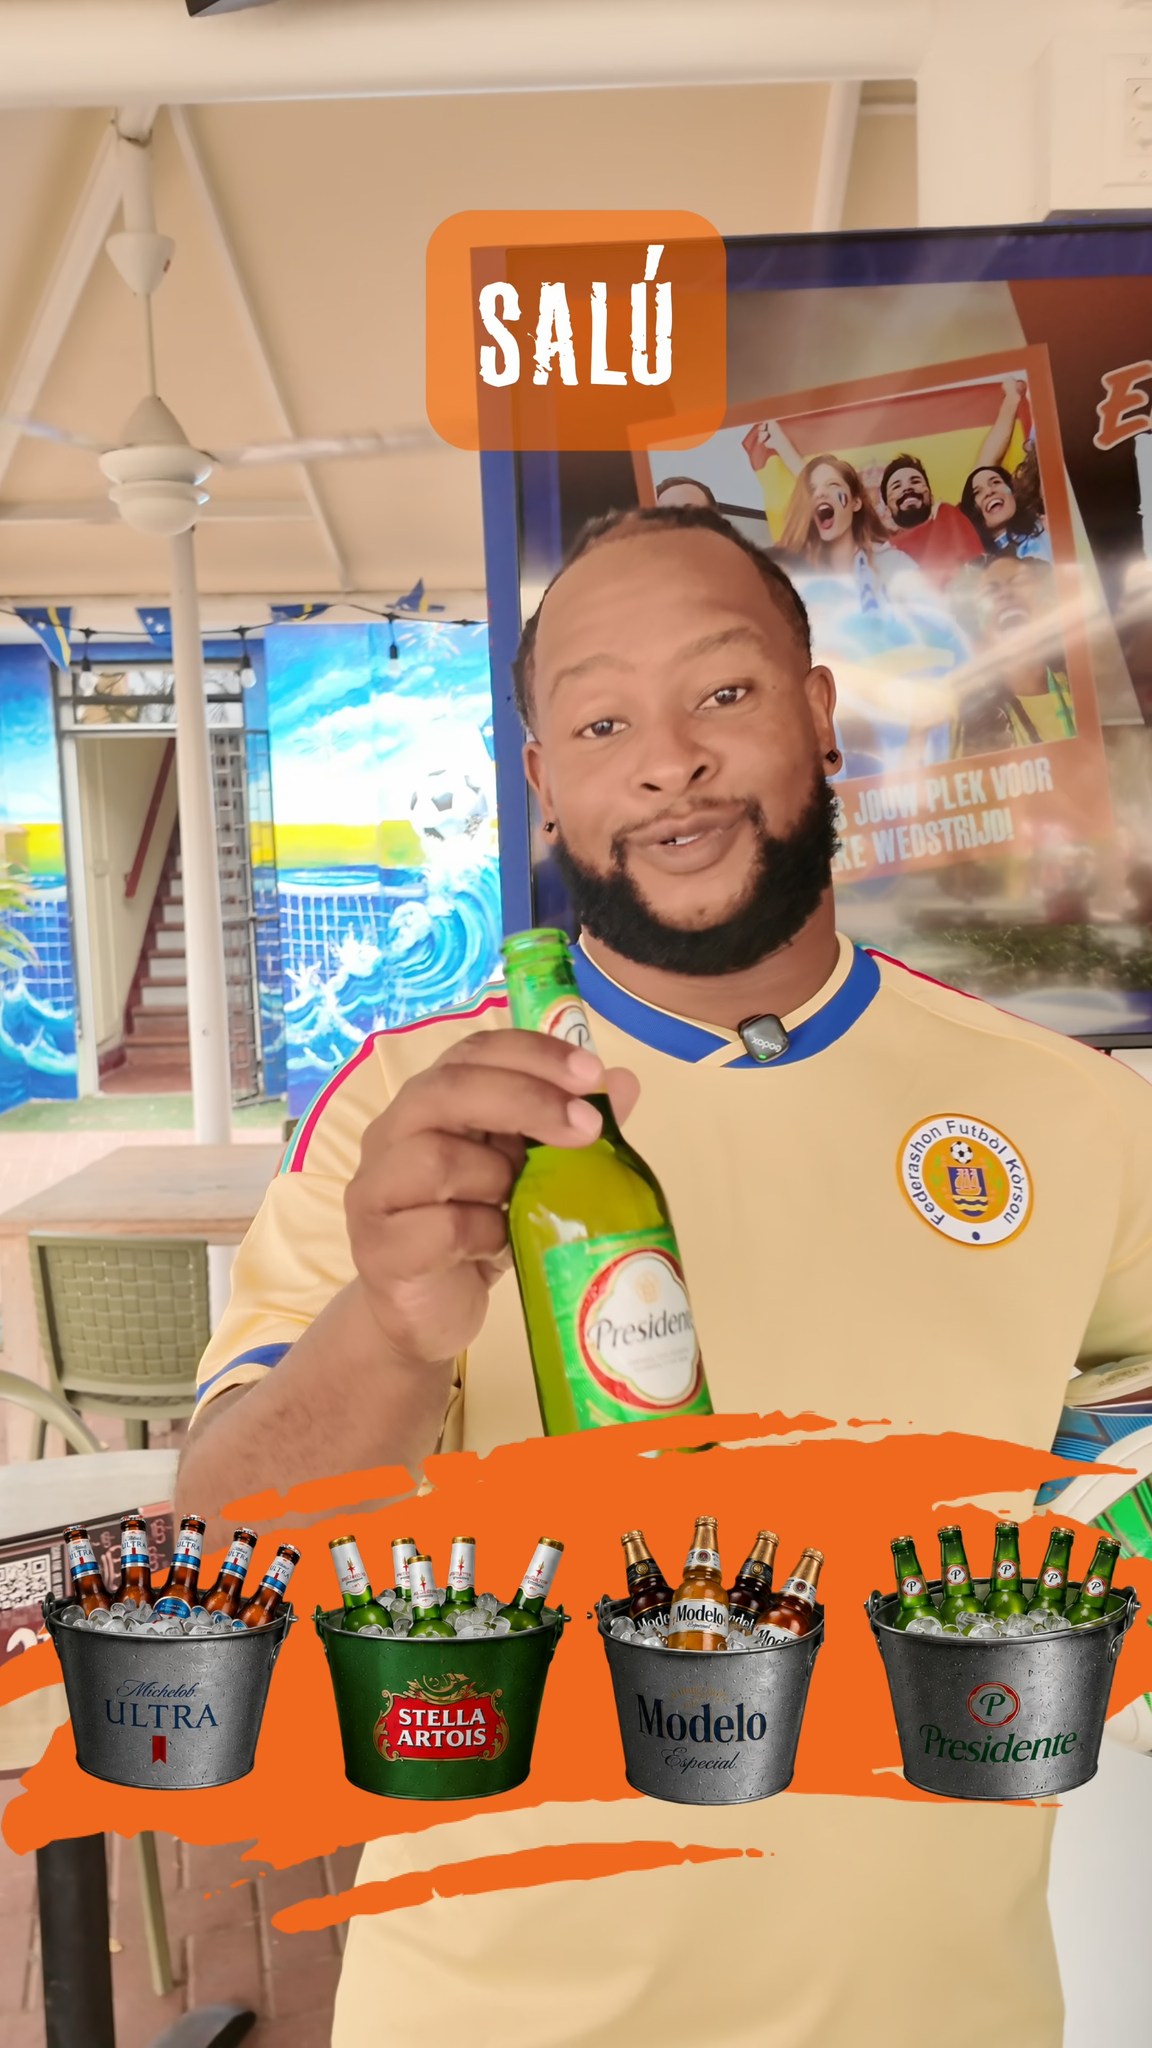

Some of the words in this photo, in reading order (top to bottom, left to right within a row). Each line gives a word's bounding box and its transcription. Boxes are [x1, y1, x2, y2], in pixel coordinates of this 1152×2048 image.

[1093, 360, 1152, 450] E
[854, 783, 918, 826] JOUW
[926, 769, 987, 813] PLEK
[989, 757, 1053, 801] VOOR
[830, 834, 867, 872] KE
[871, 808, 1015, 865] WEDSTRIJD!
[751, 1037, 782, 1053] Godox
[908, 1126, 945, 1226] Federashon
[587, 1309, 694, 1350] Presiden
